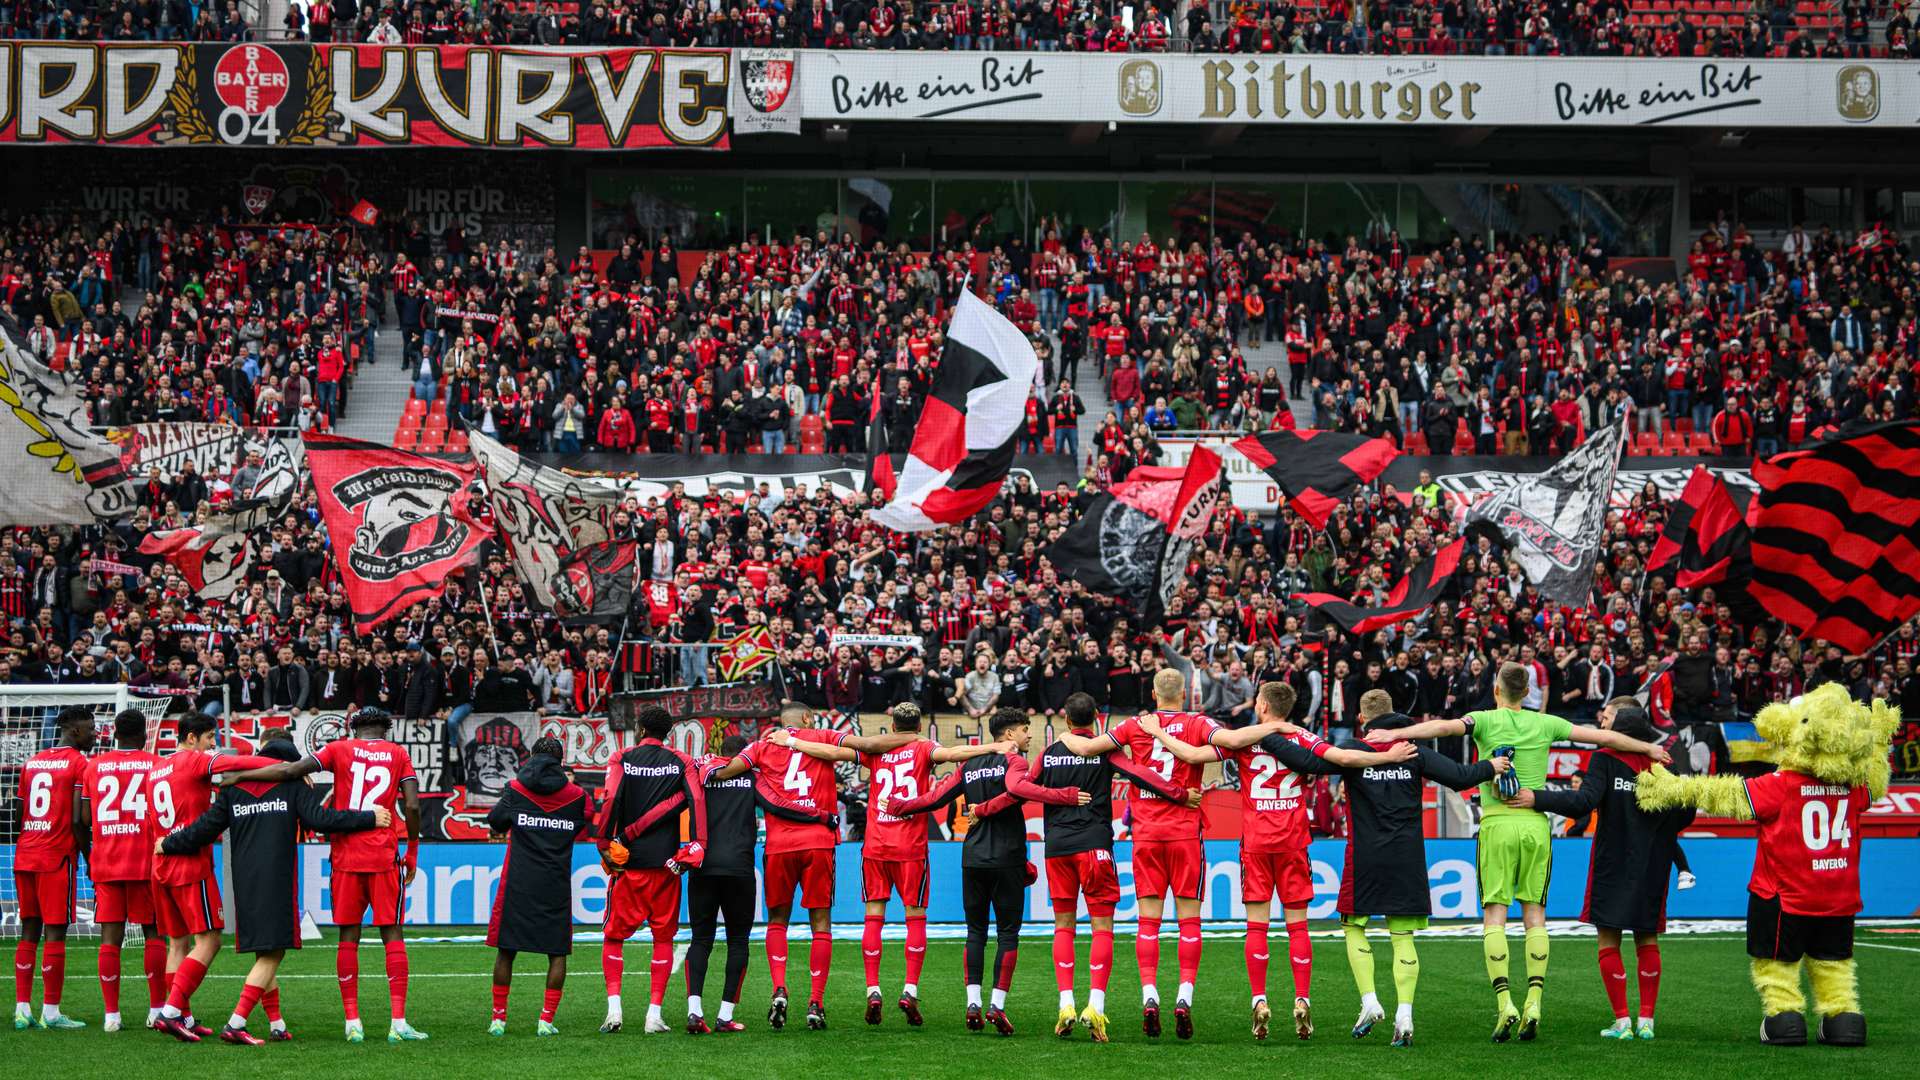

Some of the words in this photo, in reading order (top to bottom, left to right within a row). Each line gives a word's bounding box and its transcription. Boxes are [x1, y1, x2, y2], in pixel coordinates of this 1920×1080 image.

[0, 43, 181, 139] RD
[329, 46, 730, 147] KURVE
[217, 72, 286, 86] BAYER
[832, 75, 908, 113] Bitte
[917, 75, 975, 100] ein
[982, 57, 1044, 91] Bit
[1199, 60, 1482, 122] Bitburger
[1555, 82, 1629, 120] Bitte
[1639, 82, 1694, 106] ein
[1701, 64, 1761, 97] Bit
[218, 105, 281, 145] 04
[408, 189, 450, 212] IHR
[454, 185, 503, 212] FÜR
[429, 212, 482, 236] US
[97, 761, 153, 773] FOSU-MENSAH
[353, 747, 392, 762] TAPSOBA
[623, 761, 680, 778] Barmenia
[783, 751, 811, 797] 4
[29, 772, 53, 817] 6
[97, 773, 148, 821] 24
[153, 780, 176, 829] 9
[232, 798, 288, 817] Barmenia
[349, 761, 391, 812] 12
[875, 760, 918, 813] 25
[1800, 785, 1825, 796] BRIAN
[517, 813, 574, 831] Barmenia
[1801, 799, 1852, 851] 04
